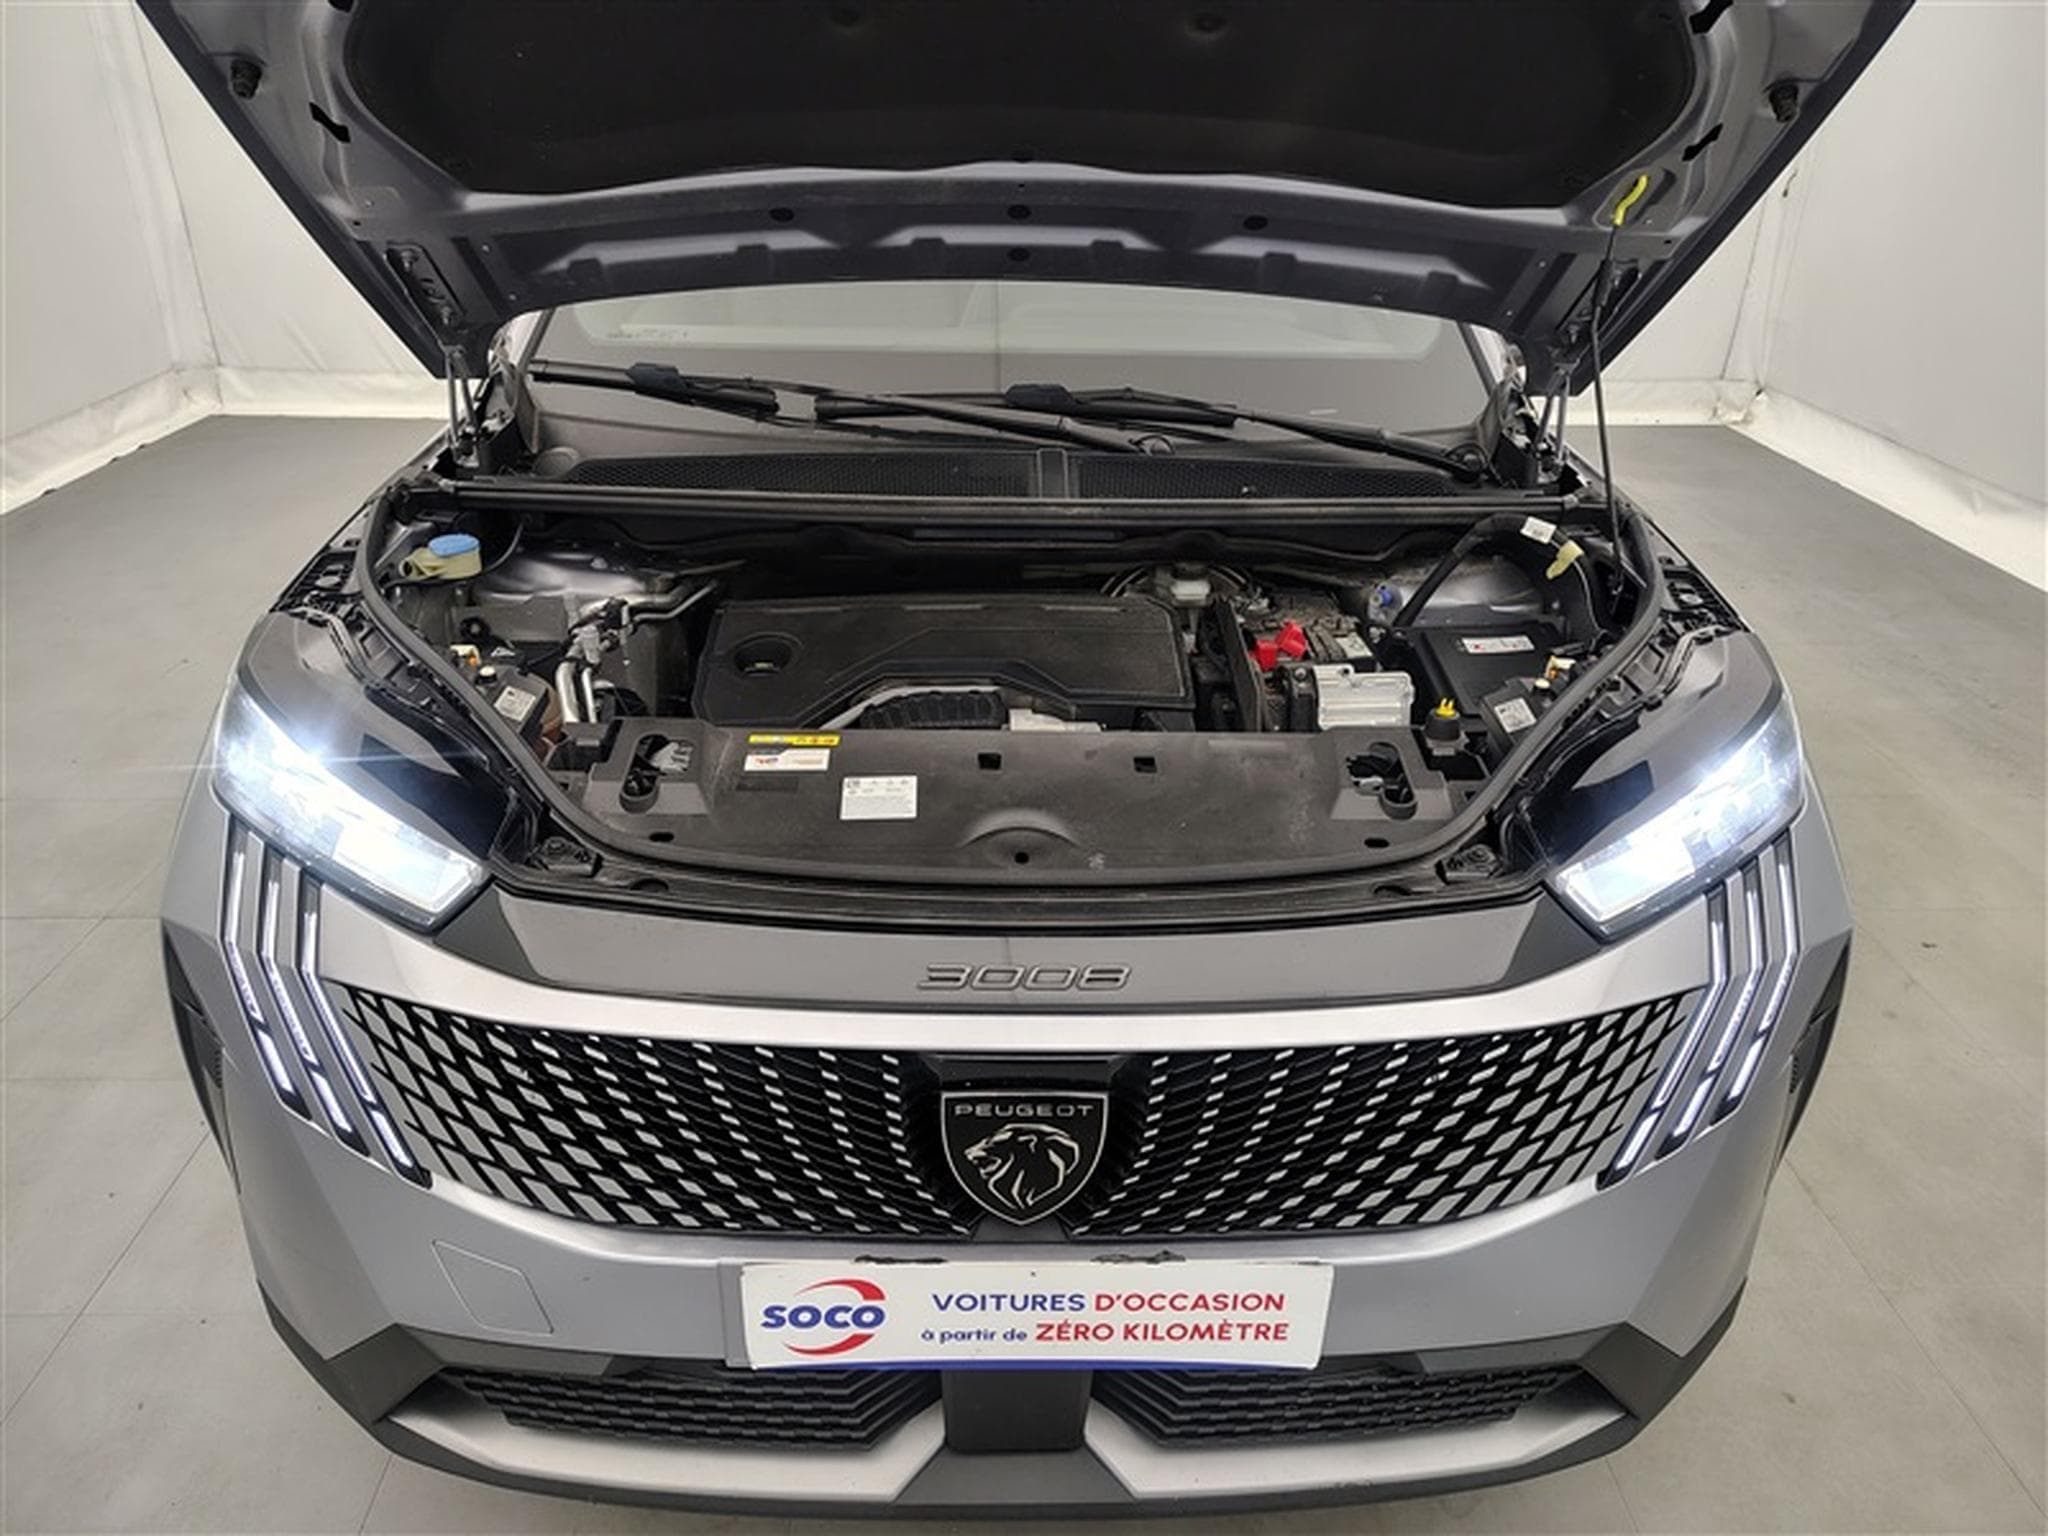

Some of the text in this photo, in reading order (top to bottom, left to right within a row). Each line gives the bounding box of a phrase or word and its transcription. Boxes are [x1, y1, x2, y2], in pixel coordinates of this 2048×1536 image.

[917, 963, 1131, 991] 3008
[954, 1104, 1094, 1118] PEUGEOT
[932, 1293, 1286, 1312] VOITURES D'OCCASION
[760, 1304, 886, 1330] SOCO
[921, 1318, 1290, 1344] à partir de ZÉRO KILOMÈTRE
